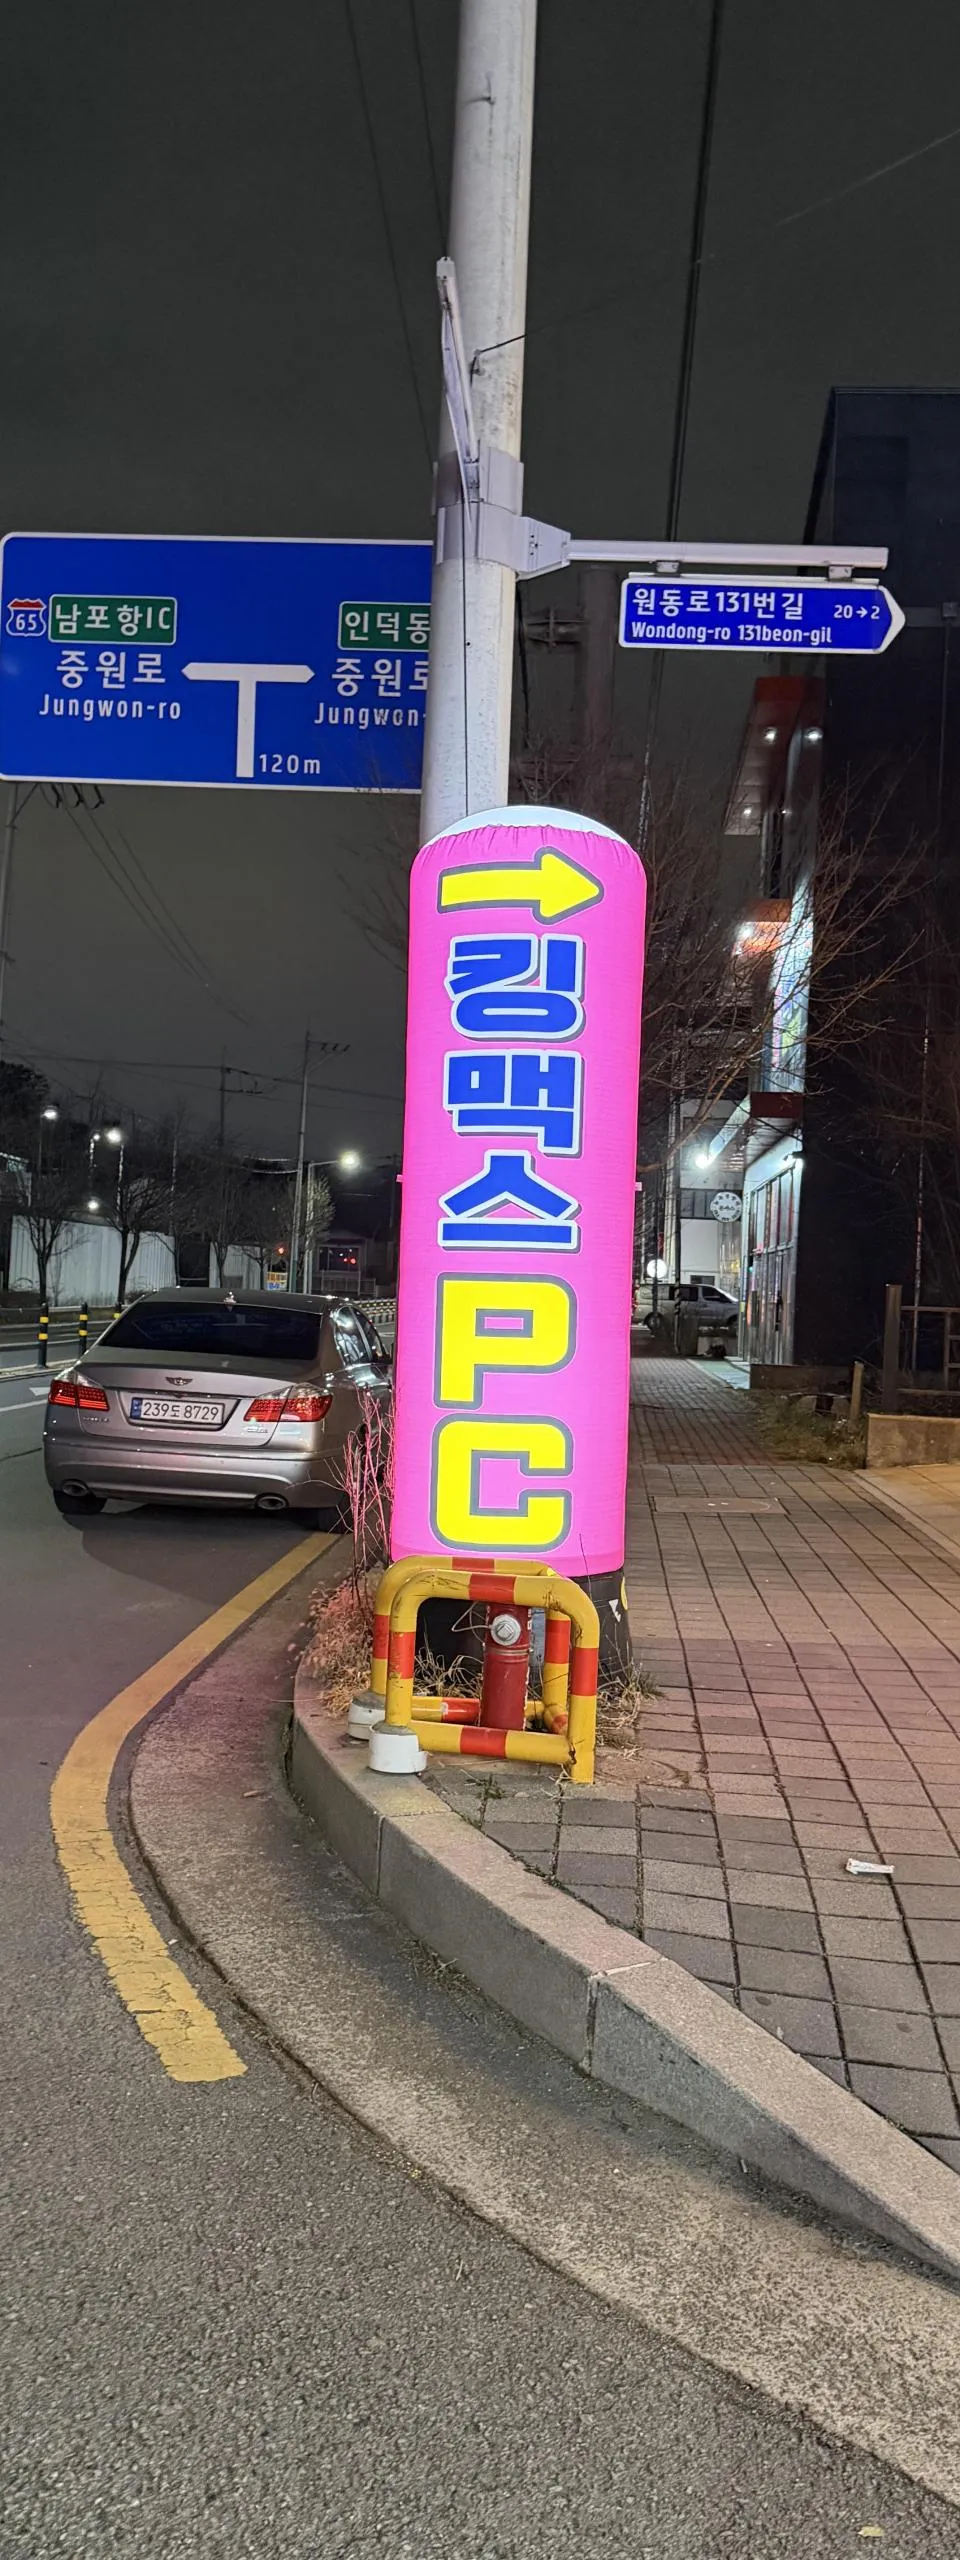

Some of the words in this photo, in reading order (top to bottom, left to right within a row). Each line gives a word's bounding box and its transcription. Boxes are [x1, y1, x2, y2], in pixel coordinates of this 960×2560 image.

[632, 588, 804, 621] 원동로131번길
[833, 604, 853, 620] 20
[871, 604, 880, 620] 2
[15, 613, 37, 631] 65
[55, 603, 171, 637] 남포항IC
[344, 610, 431, 645] 인덕동
[631, 622, 731, 643] Wondong-ro
[737, 624, 832, 646] 131beon-gil
[56, 650, 166, 690] 중원로
[38, 693, 182, 722] Jungwon-ro
[258, 753, 321, 775] 120m
